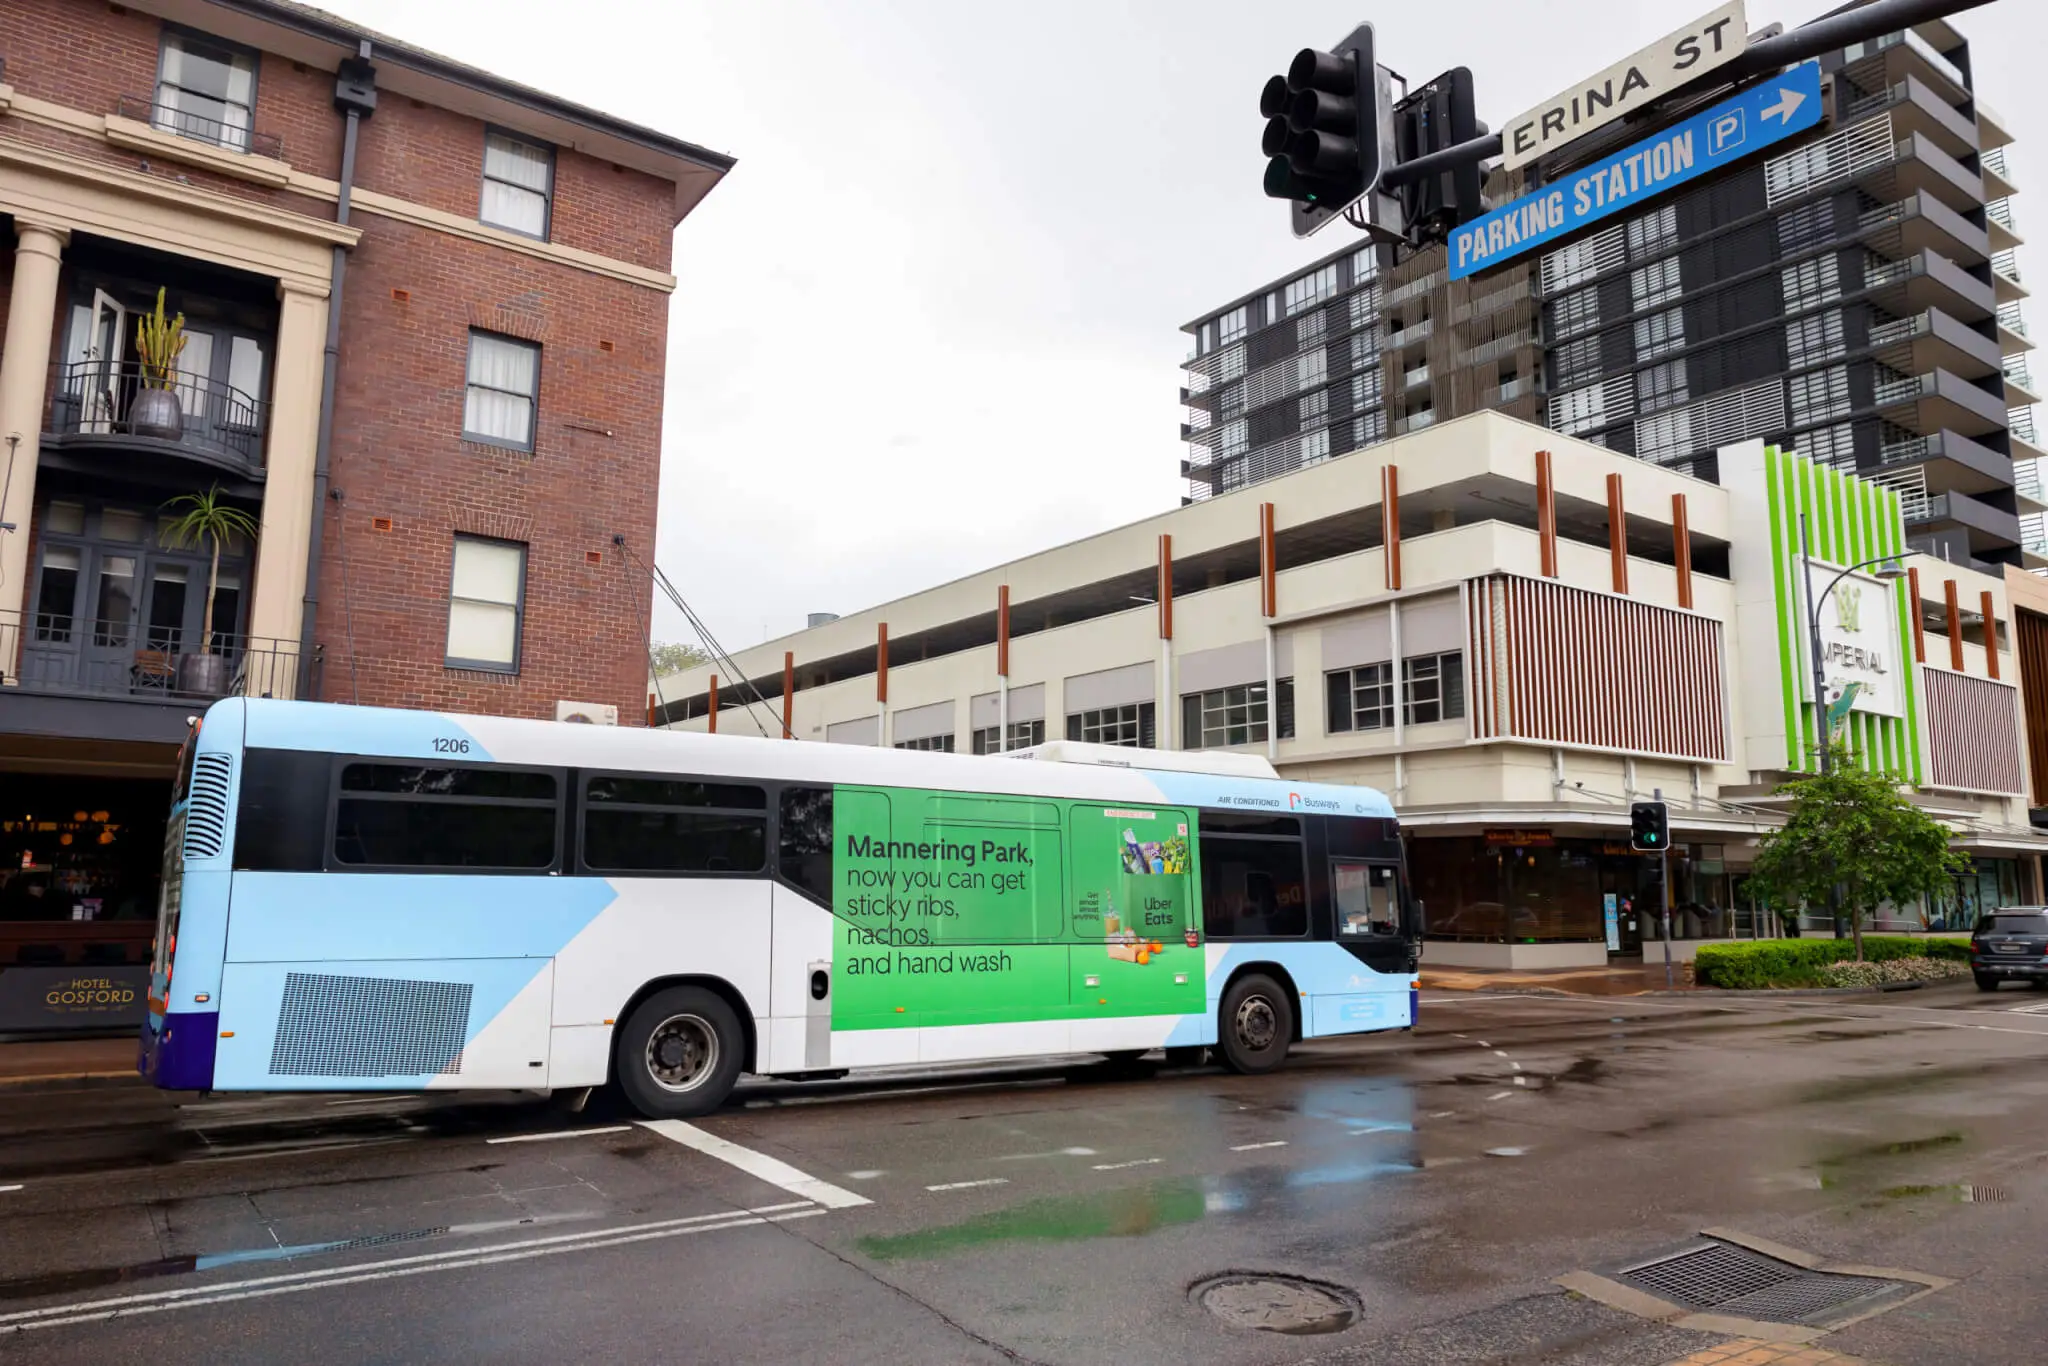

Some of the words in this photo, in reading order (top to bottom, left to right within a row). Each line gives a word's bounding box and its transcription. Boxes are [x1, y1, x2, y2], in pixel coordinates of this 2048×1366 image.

[1513, 66, 1650, 155] ERINA
[1673, 17, 1732, 70] ST
[1457, 190, 1565, 268] PARKING
[1573, 129, 1694, 217] STATION
[1821, 641, 1888, 674] MPERIAL
[431, 738, 469, 754] 1206
[1217, 796, 1231, 805] AIR
[1234, 797, 1280, 807] CONDITIONED
[1305, 797, 1340, 811] Busways
[847, 834, 976, 867] Mannering
[981, 840, 1034, 866] Park,
[847, 869, 896, 888] now
[902, 871, 941, 893] you
[947, 872, 985, 889] can
[991, 871, 1026, 894] get
[847, 894, 911, 921] sticky
[917, 895, 959, 919] ribs,
[1144, 898, 1172, 911] Uber
[1145, 912, 1173, 926] Eats
[847, 921, 935, 947] nachos,
[847, 951, 891, 974] and
[898, 951, 953, 975] hand
[959, 949, 1012, 972] wash
[71, 979, 112, 989] HOTEL
[46, 990, 134, 1004] GOSFORD
